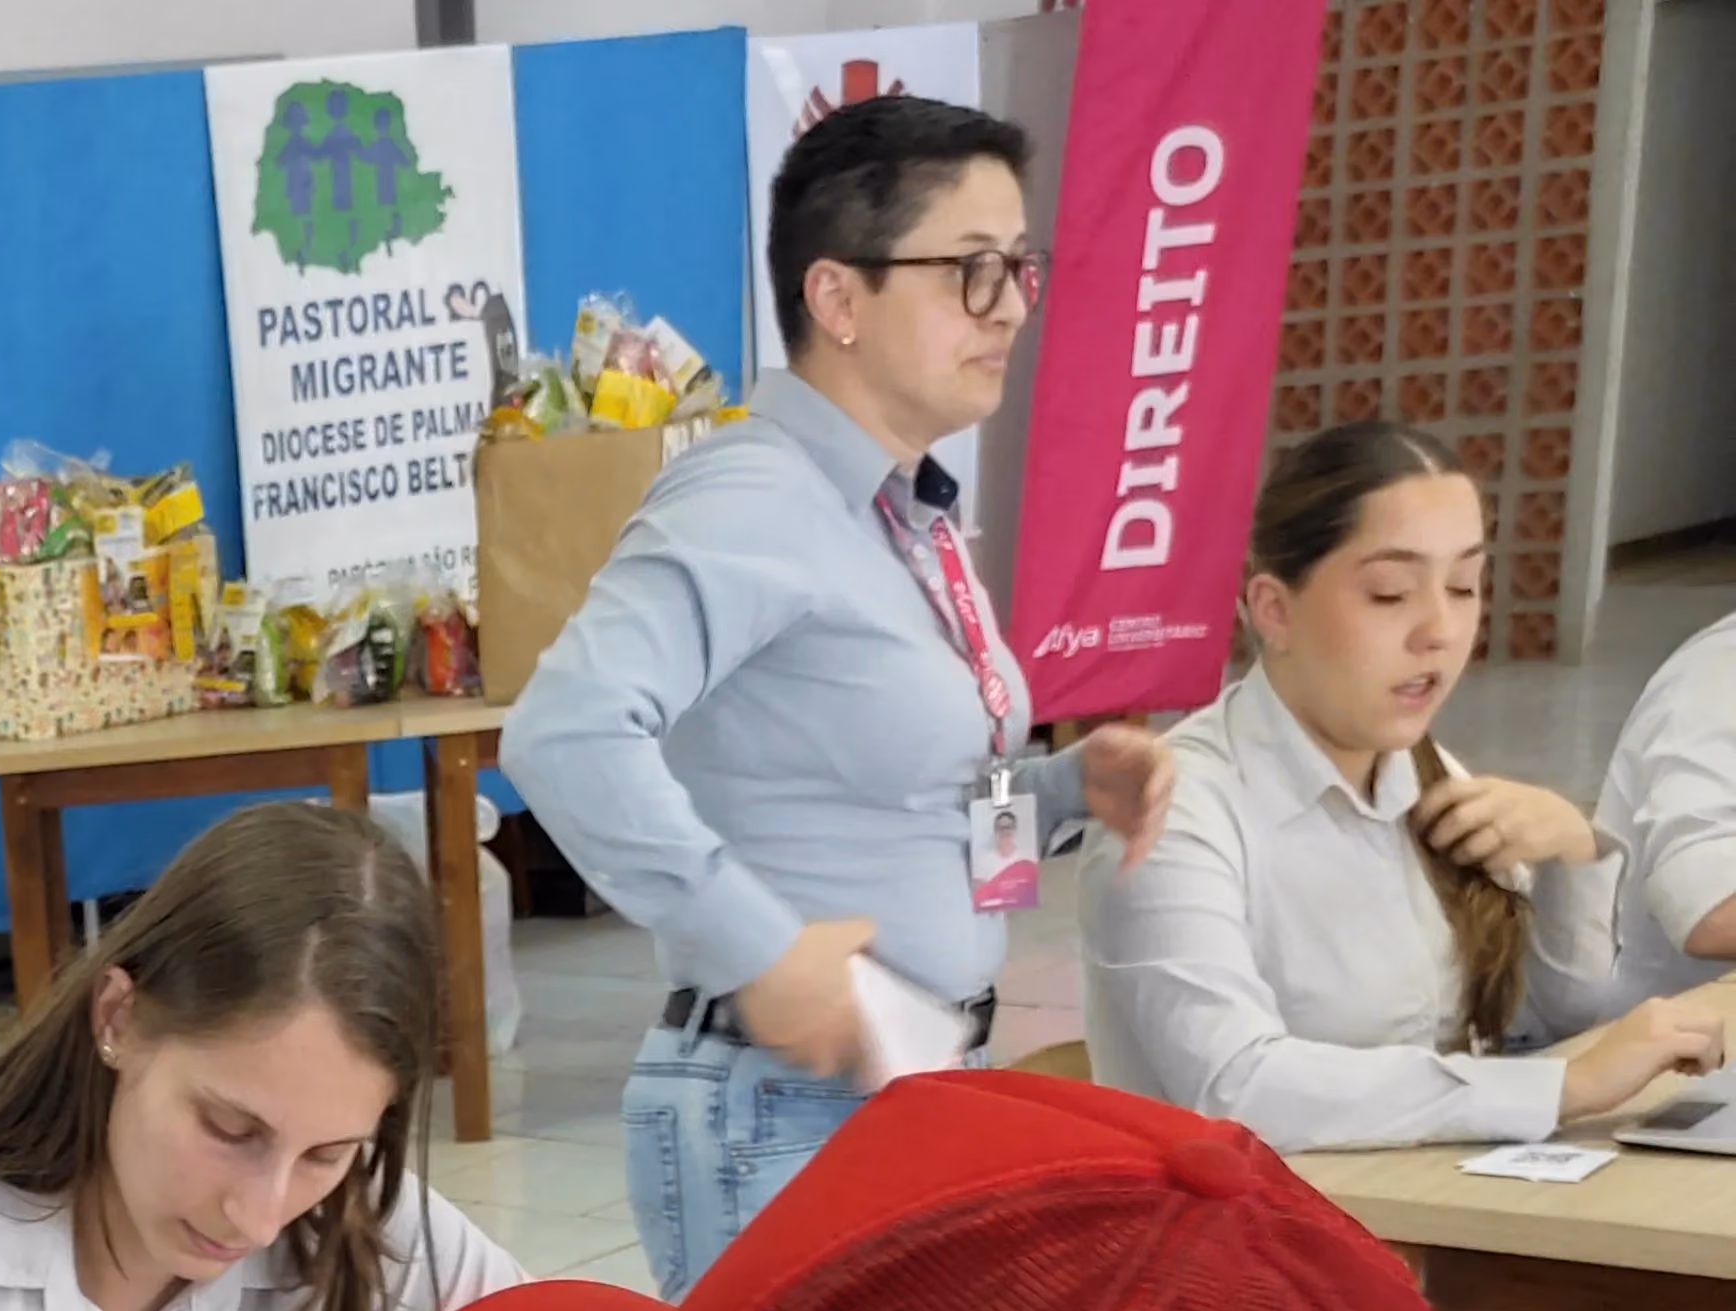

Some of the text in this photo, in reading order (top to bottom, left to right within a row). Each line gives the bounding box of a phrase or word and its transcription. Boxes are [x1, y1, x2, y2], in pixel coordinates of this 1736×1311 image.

[257, 287, 436, 347] PASTORAL
[1100, 125, 1225, 570] DIREITO
[290, 341, 469, 404] MIGRANTE
[260, 401, 485, 465] DIOCESE DE PALMA
[251, 452, 468, 522] FRANCISCO BELT
